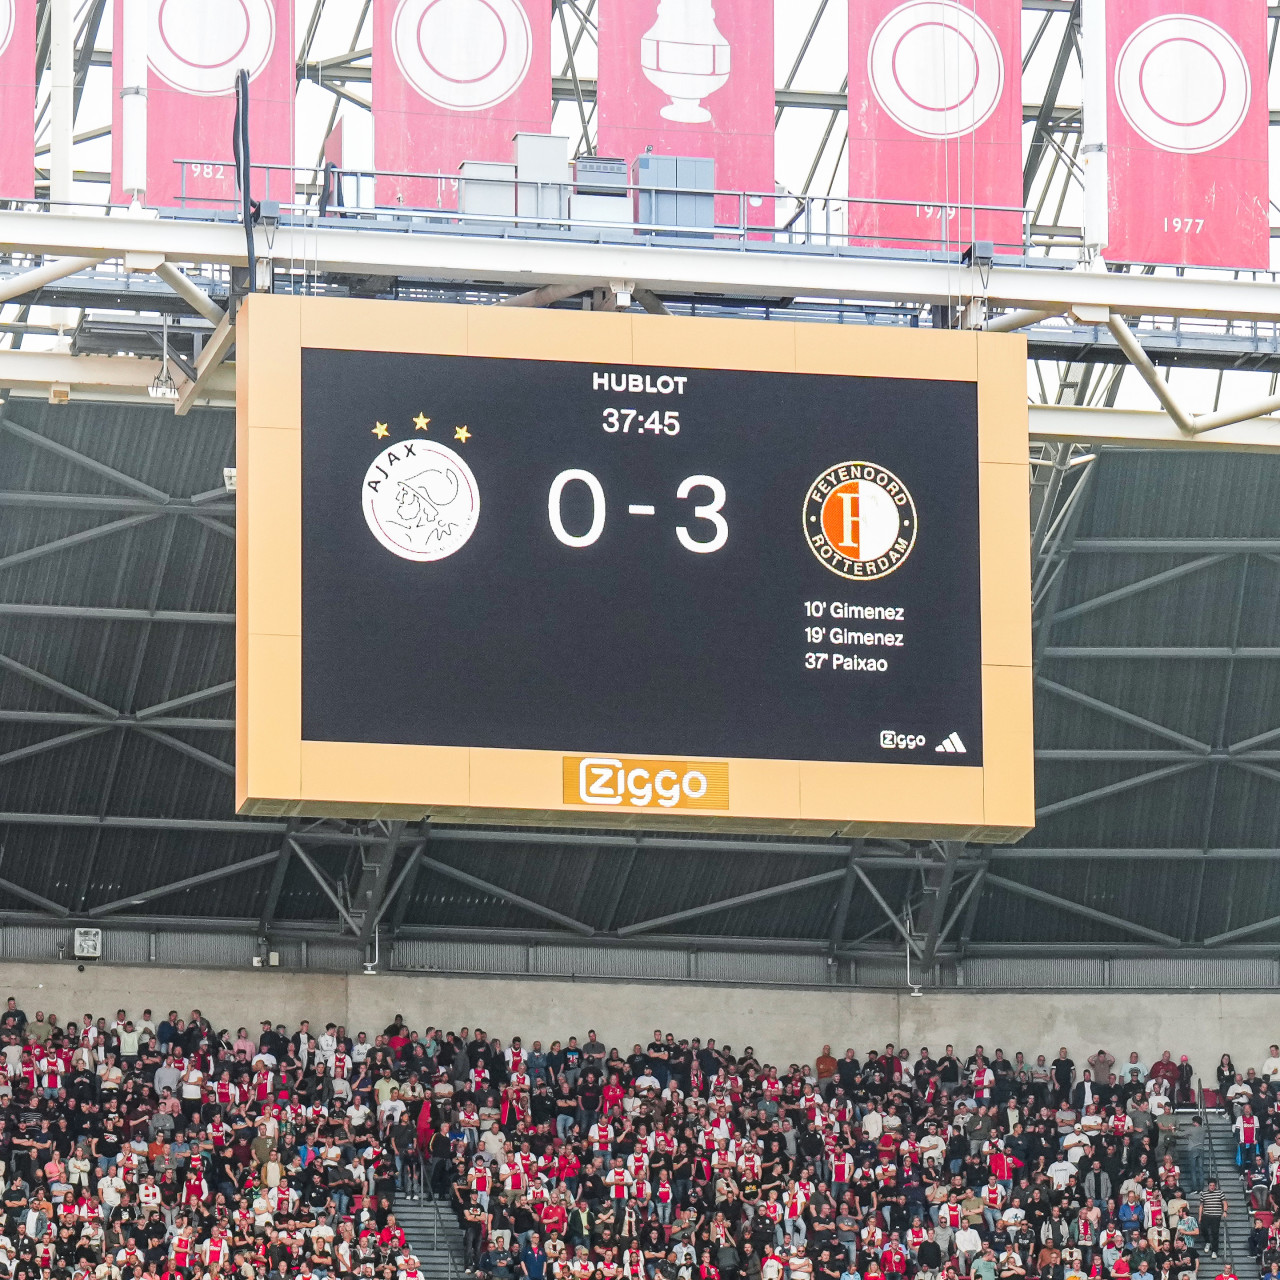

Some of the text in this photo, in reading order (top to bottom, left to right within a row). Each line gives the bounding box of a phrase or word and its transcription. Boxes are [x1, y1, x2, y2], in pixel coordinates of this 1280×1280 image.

[191, 162, 225, 179] 982
[1164, 217, 1205, 234] 1977
[593, 372, 687, 394] HUBLOT
[602, 408, 680, 436] 37:45
[367, 444, 416, 493] AJAX
[811, 465, 907, 507] FEYENOORD
[548, 469, 606, 547] 0
[675, 475, 729, 554] 3
[812, 533, 909, 576] ROTTERDAM
[804, 601, 904, 621] 10' Gimenez
[805, 627, 904, 646] 19' Gimenez
[805, 652, 888, 671] 37' Paixao
[880, 731, 926, 749] Ziggo
[579, 757, 708, 808] Ziggo
